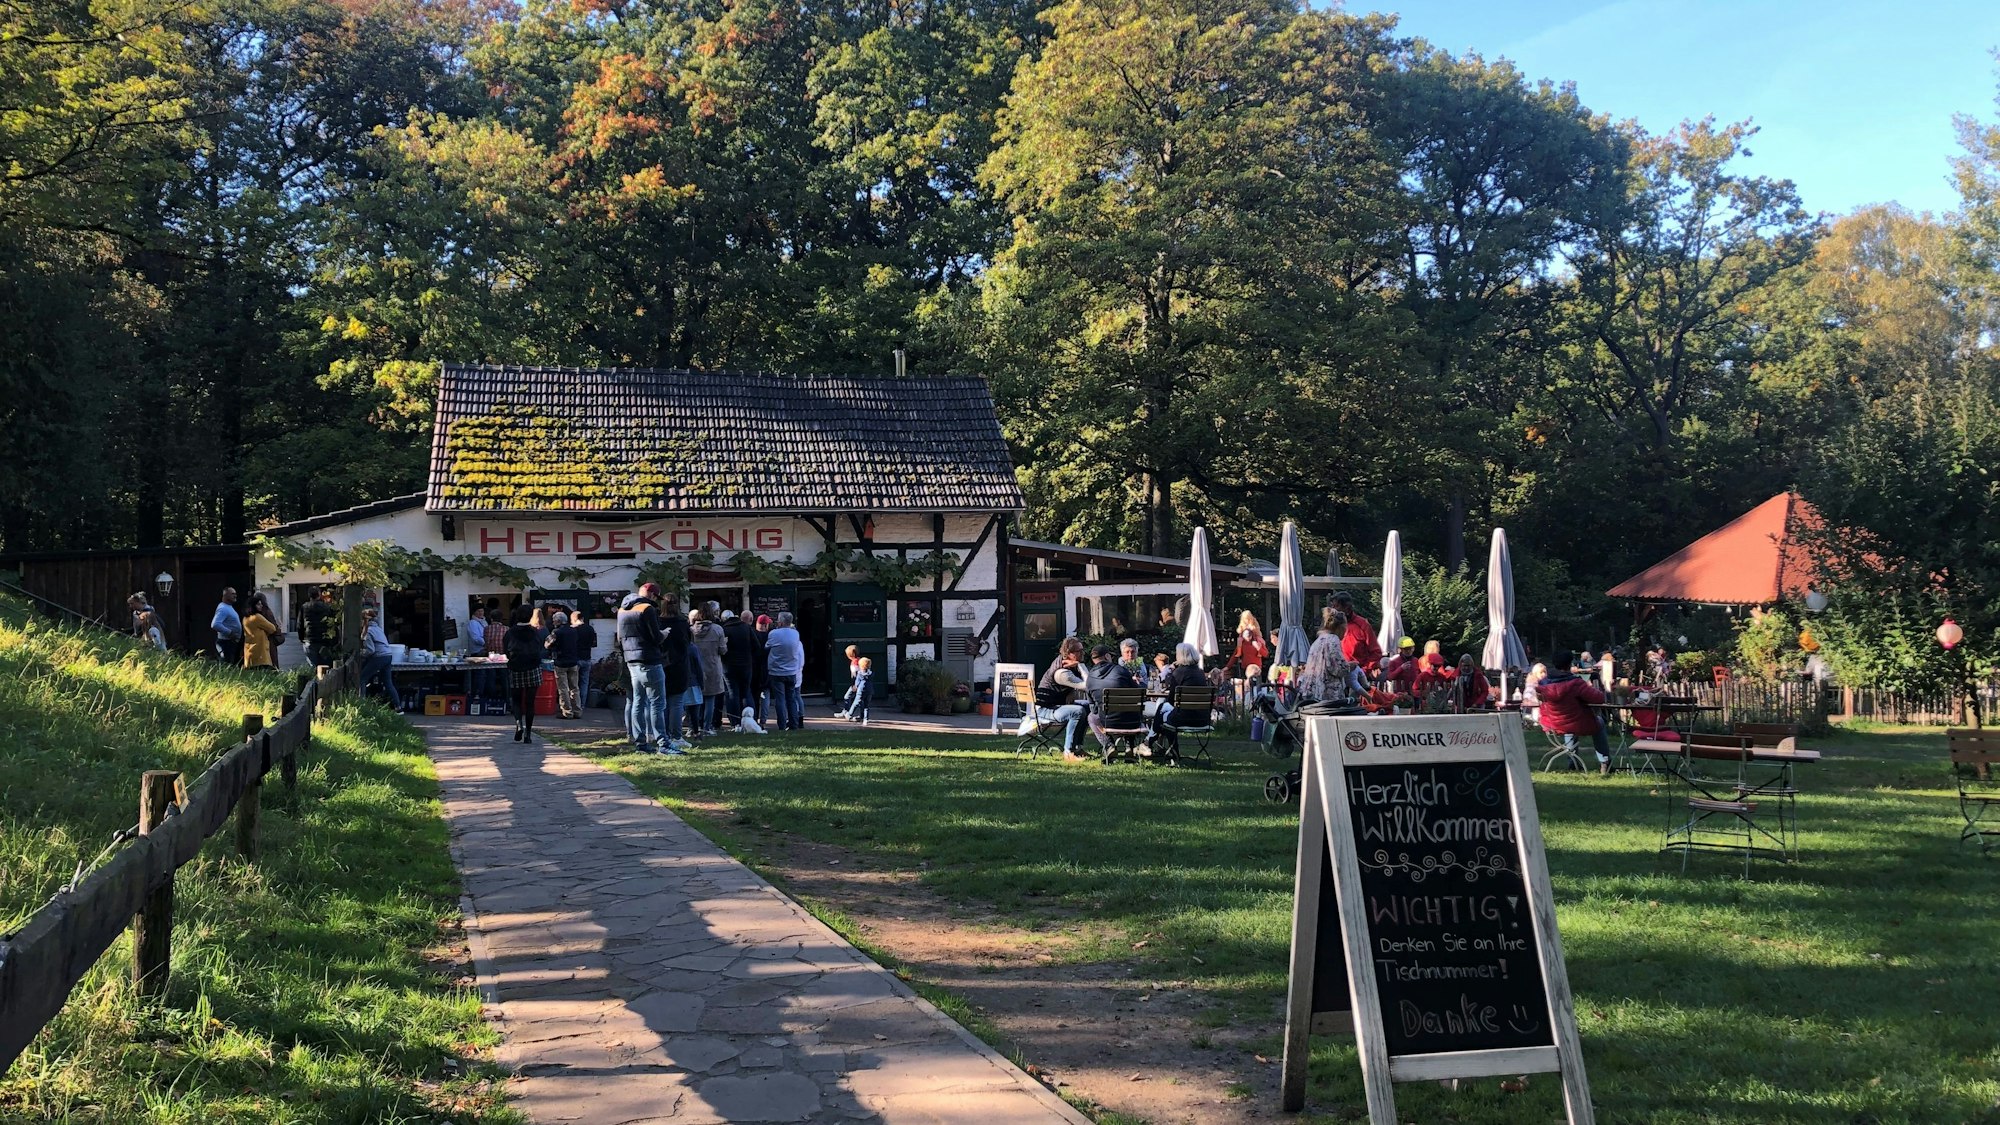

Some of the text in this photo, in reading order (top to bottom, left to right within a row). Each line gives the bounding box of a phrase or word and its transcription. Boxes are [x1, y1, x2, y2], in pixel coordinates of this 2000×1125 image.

[480, 520, 784, 553] HEIDEKÖNIG
[1372, 732, 1446, 748] ERDINGER
[1448, 730, 1497, 748] Weißbier
[1348, 768, 1449, 806] Herzlich
[1442, 933, 1468, 951] Sie
[1473, 939, 1495, 951] an
[1498, 933, 1527, 951] Ihre
[1376, 958, 1509, 982] Tischnummer!
[1400, 993, 1501, 1038] Danke
